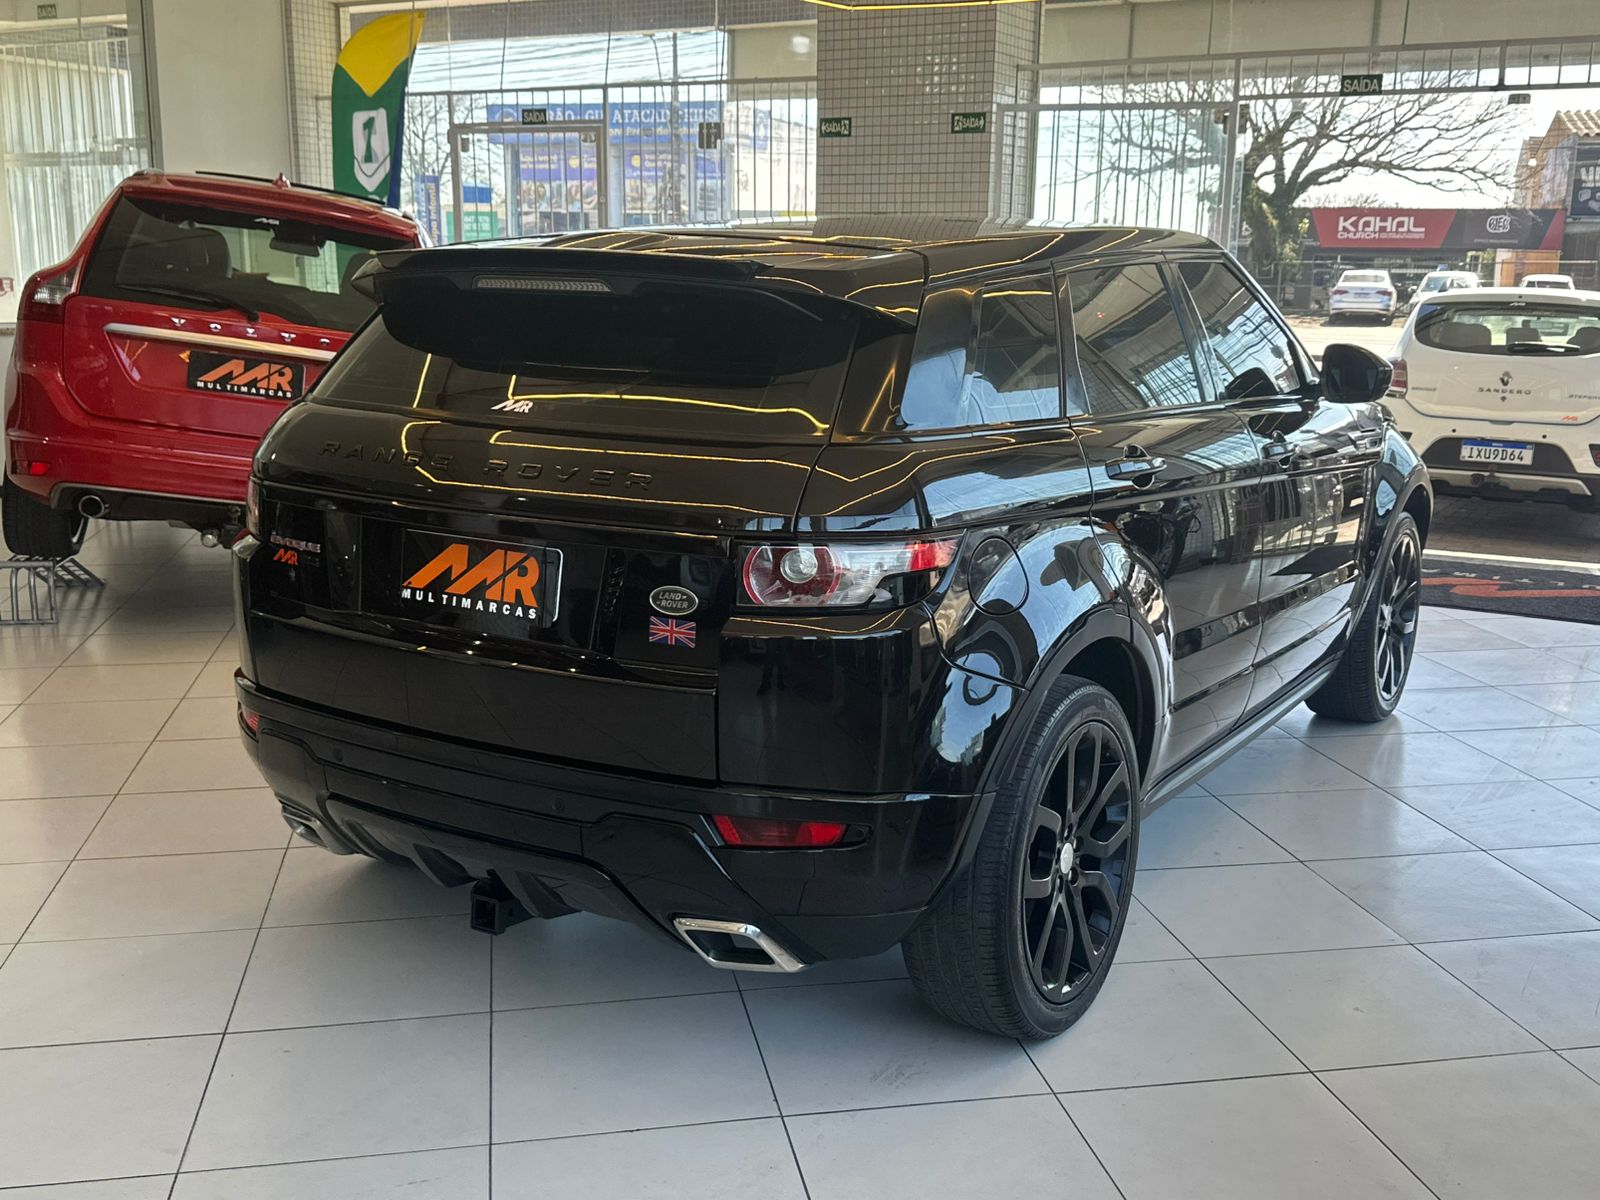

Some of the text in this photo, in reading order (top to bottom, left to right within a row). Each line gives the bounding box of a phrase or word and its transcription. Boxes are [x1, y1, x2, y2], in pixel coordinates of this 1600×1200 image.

[1343, 76, 1380, 93] SAÍDA
[523, 110, 546, 124] SAÍDA
[962, 116, 979, 129] SAÍDA
[826, 121, 842, 133] SAÍDA
[1338, 216, 1426, 232] KAHAL
[196, 380, 292, 398] MULTIMARCAS
[1477, 387, 1532, 396] SANDERO
[1468, 447, 1524, 462] IXU9D64
[319, 440, 655, 490] RANGE ROVER
[658, 591, 682, 601] LAND
[400, 587, 538, 621] MULTIMARCAS
[660, 600, 689, 609] ROVER
